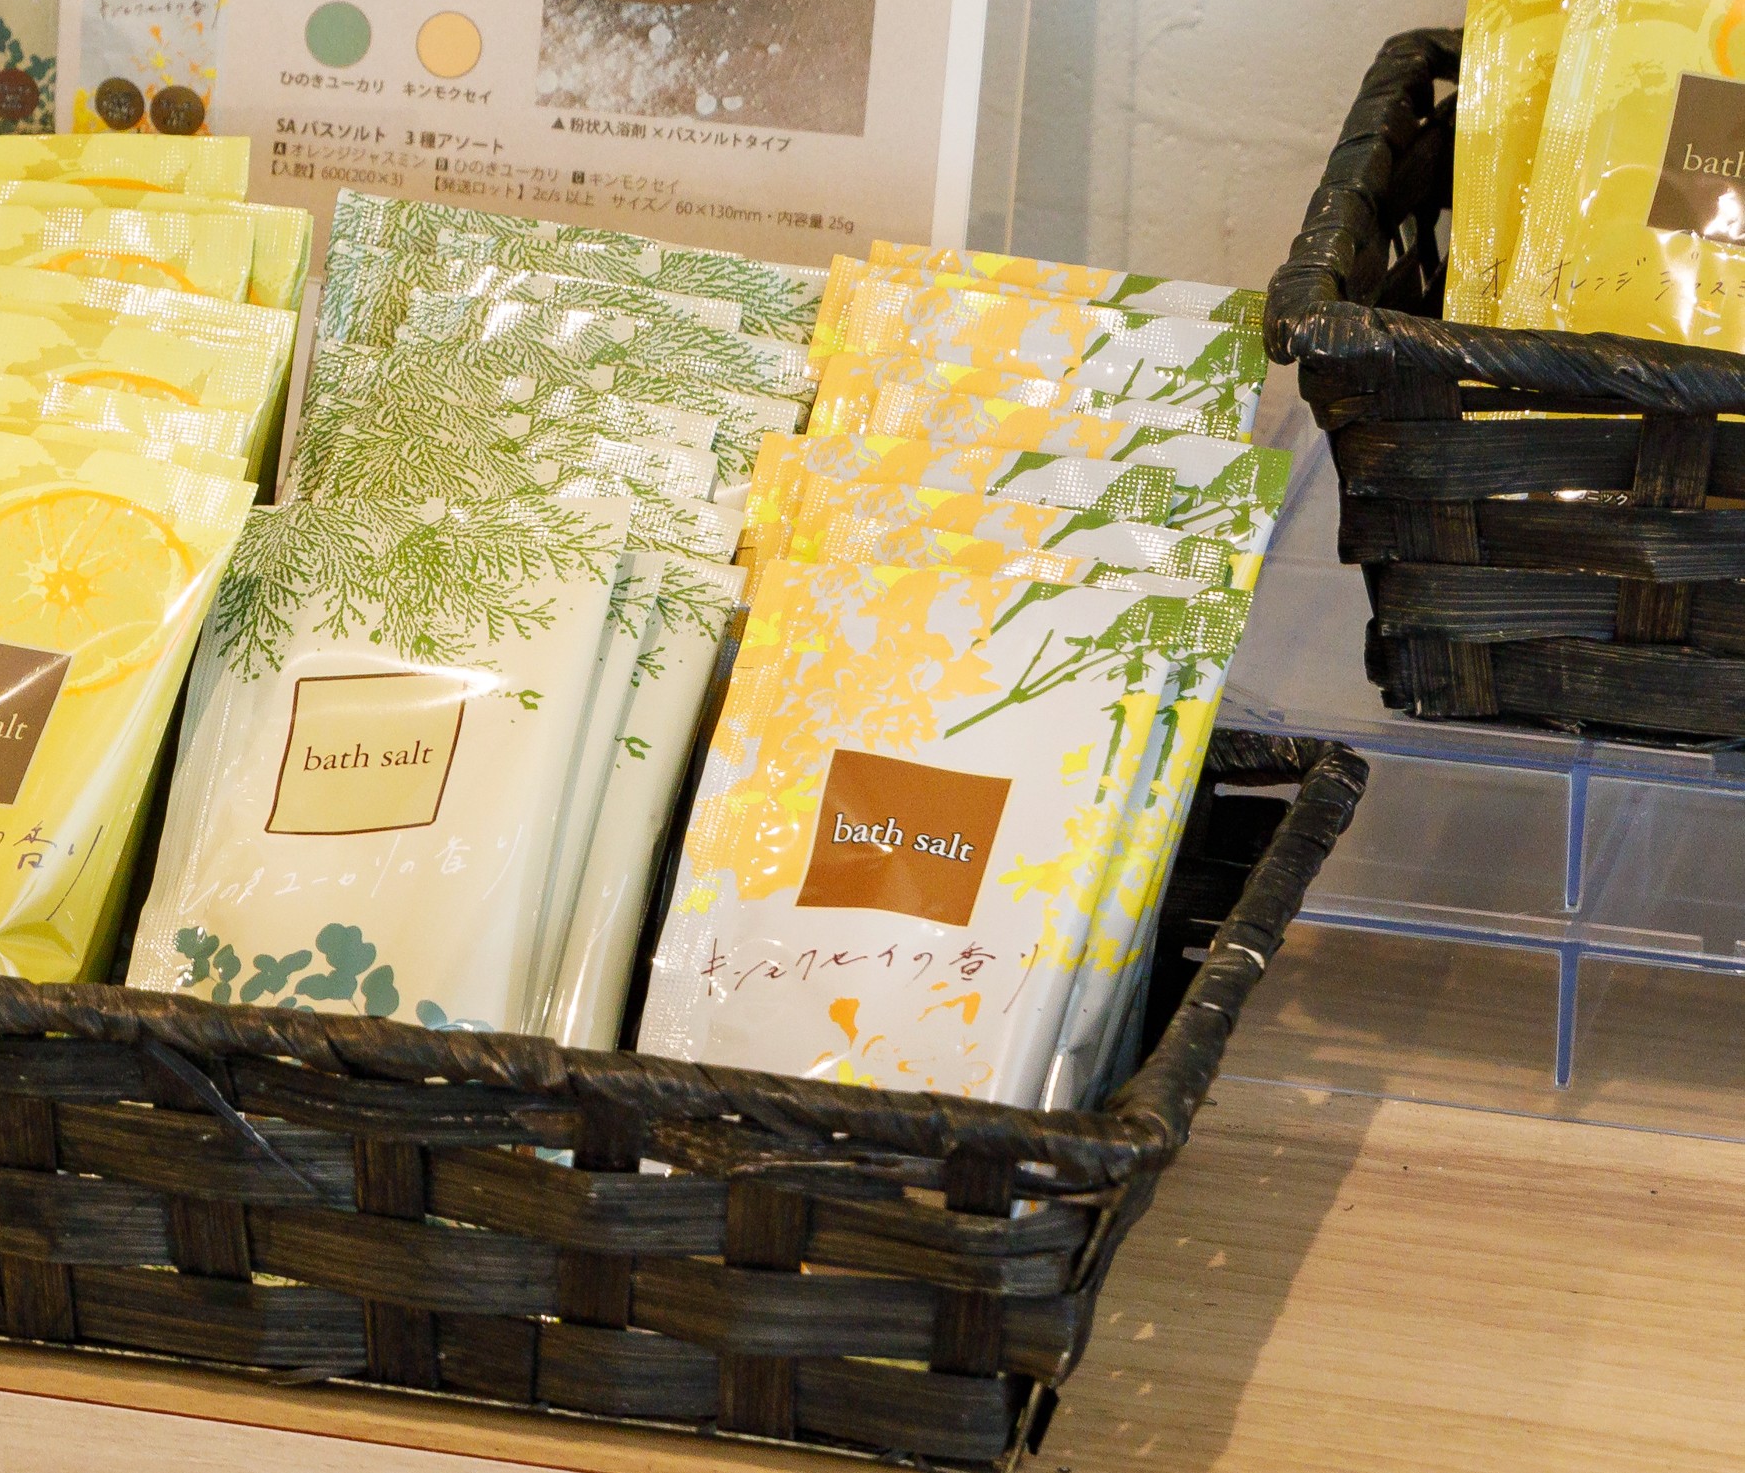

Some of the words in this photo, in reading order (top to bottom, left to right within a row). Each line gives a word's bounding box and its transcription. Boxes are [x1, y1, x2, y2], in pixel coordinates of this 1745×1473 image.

[280, 70, 385, 94] ひのきユーカリ
[403, 81, 491, 105] キンモクセイ
[455, 158, 559, 182] ひのきユーカリ
[590, 173, 679, 195] キンモクセイ
[302, 744, 370, 772] bath
[381, 740, 434, 769] salt
[832, 813, 904, 850] bath
[911, 831, 975, 864] salt
